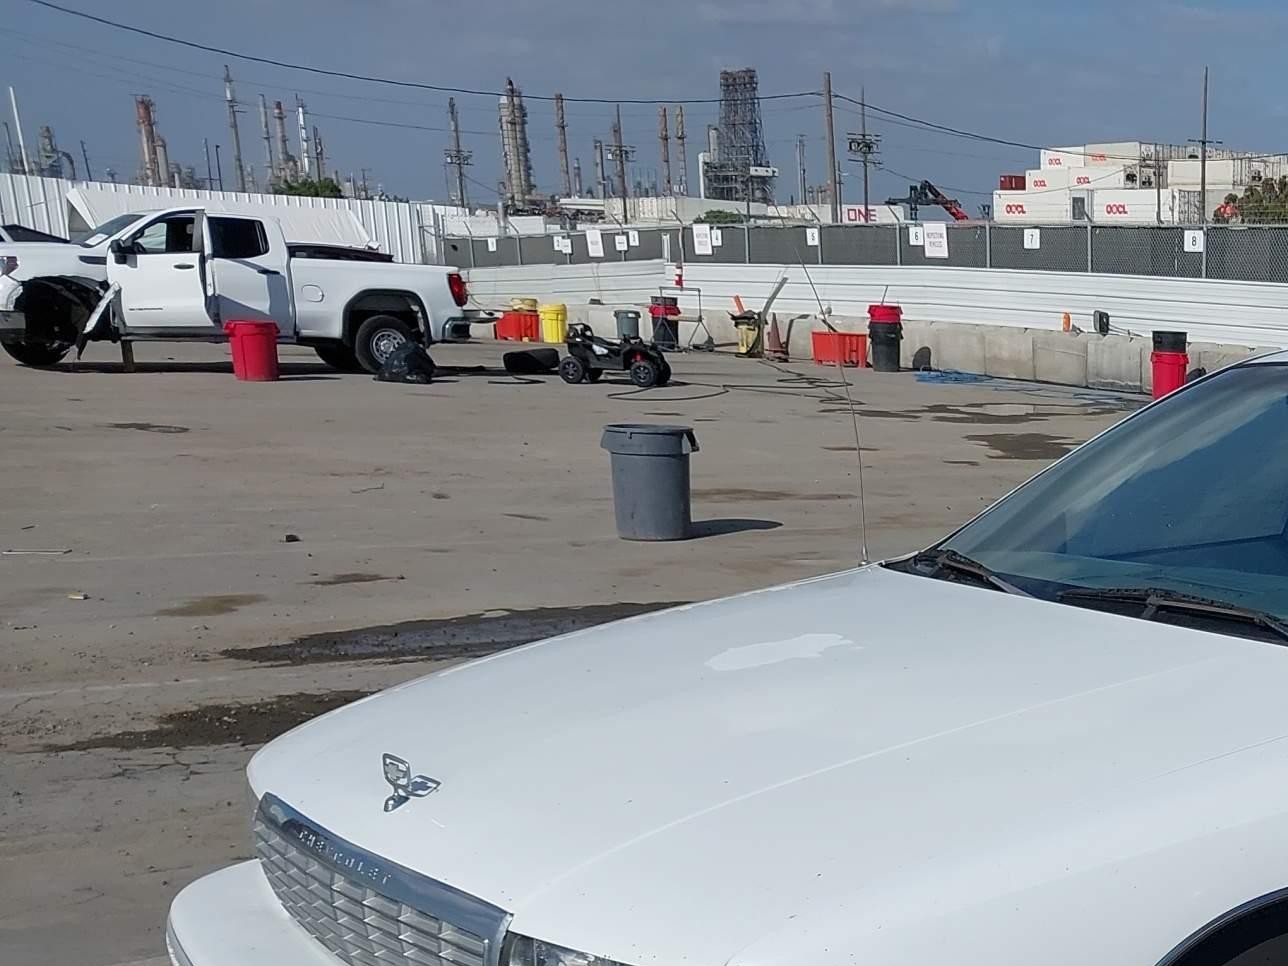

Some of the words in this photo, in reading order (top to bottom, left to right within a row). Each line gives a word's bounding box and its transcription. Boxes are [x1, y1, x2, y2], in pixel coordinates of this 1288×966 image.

[1005, 203, 1026, 215] OOCL
[1106, 203, 1128, 215] OOCL
[847, 208, 877, 222] ONE
[914, 231, 919, 241] 6
[1030, 234, 1034, 245] 7
[1191, 236, 1197, 247] 8
